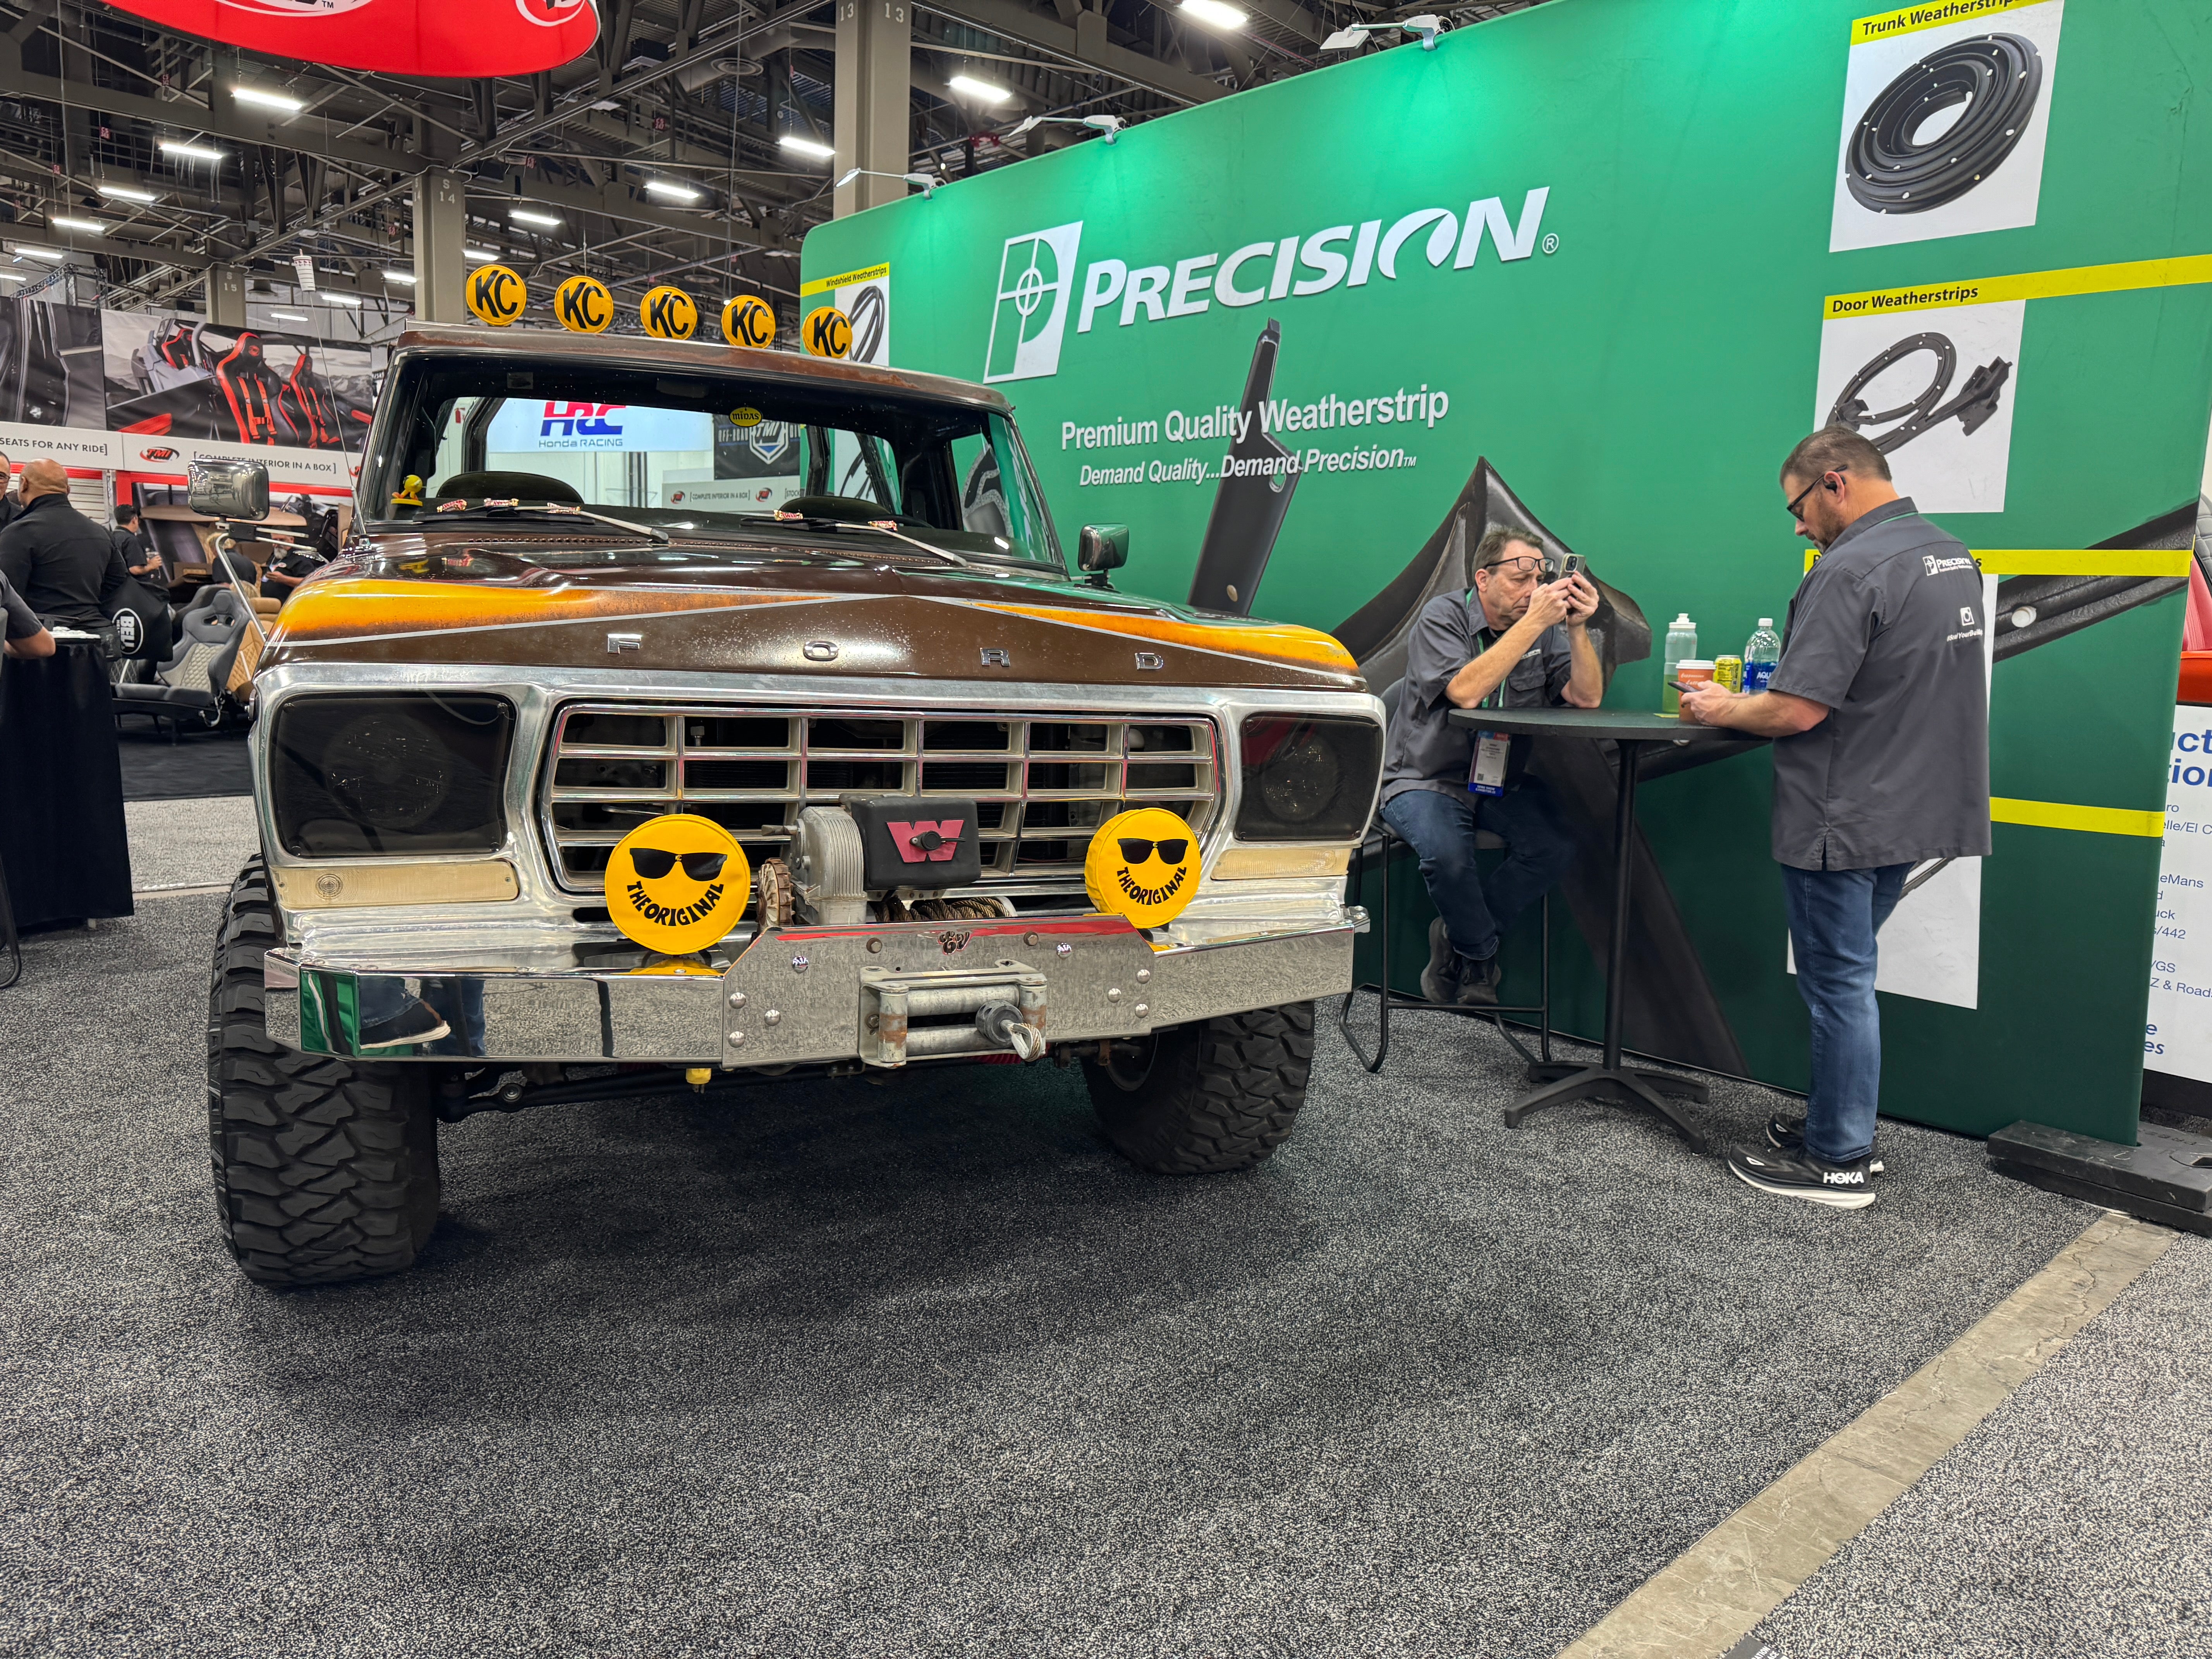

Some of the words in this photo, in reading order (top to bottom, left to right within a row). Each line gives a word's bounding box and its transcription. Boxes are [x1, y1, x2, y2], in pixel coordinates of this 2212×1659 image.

[885, 2, 904, 23] 13
[1863, 14, 1906, 35] Trunk
[1910, 0, 2014, 26] Weatherst
[440, 191, 455, 204] 14
[443, 179, 450, 189] S
[1077, 187, 1550, 333] PRECISION
[224, 283, 237, 292] 15
[826, 274, 852, 287] Windshield
[852, 266, 887, 281] Weatherstrips
[476, 270, 518, 318] KC
[563, 282, 605, 329] KC
[1832, 300, 1868, 313] Door
[1872, 286, 1978, 308] Weatherstrips
[649, 292, 689, 338] KC
[731, 301, 768, 346] KC
[813, 312, 848, 356] KC
[540, 401, 626, 436] HRC
[1062, 421, 1158, 450] Premium
[1165, 405, 1252, 444] Quality
[1259, 384, 1449, 433] Weatherstrip
[0, 438, 29, 447] SEATS
[33, 440, 53, 449] FOR
[57, 442, 79, 452] ANY
[146, 448, 173, 460] TMI
[539, 439, 577, 448] Honda
[580, 438, 623, 448] RACING
[1080, 462, 1146, 486] Demand
[1304, 448, 1405, 472] Precision
[2163, 980, 2172, 991] &
[1823, 1171, 1865, 1184] HOKA
